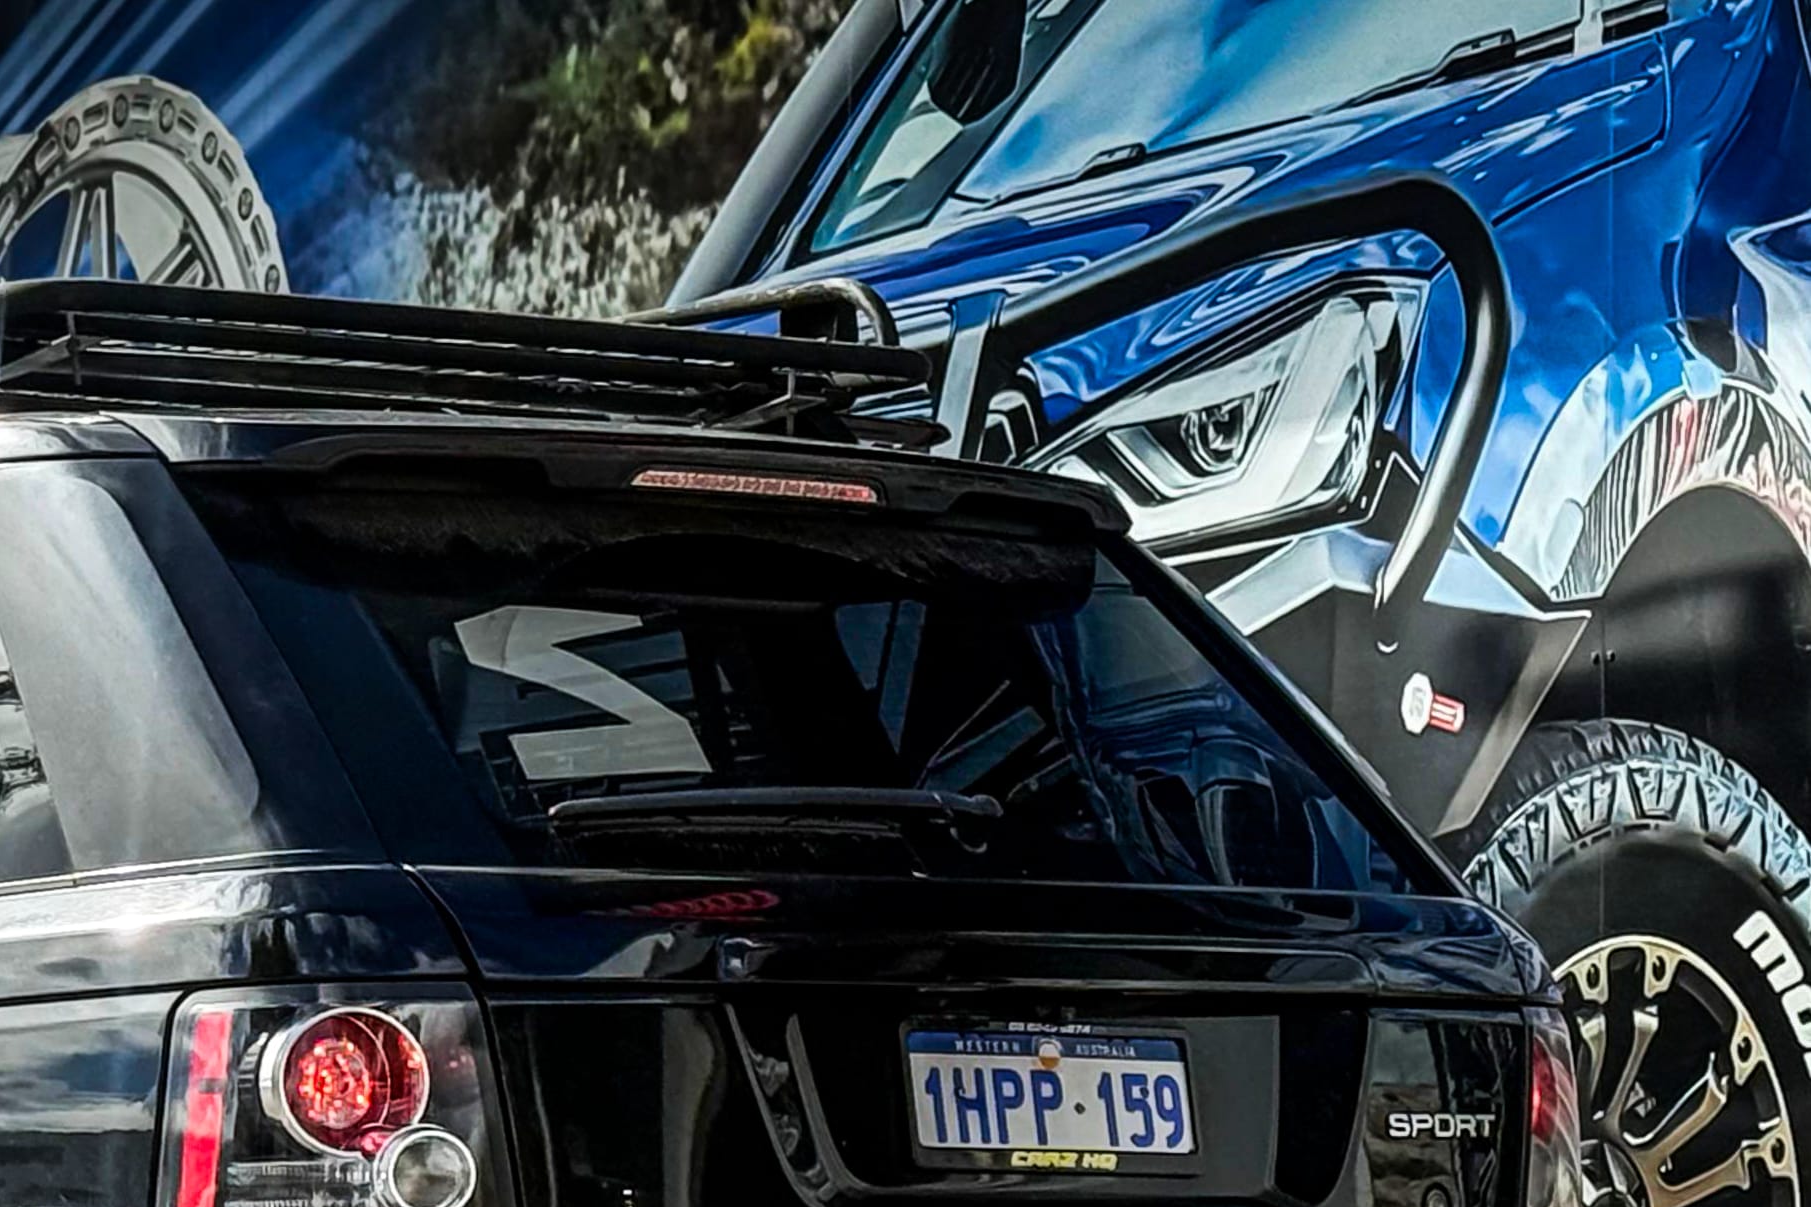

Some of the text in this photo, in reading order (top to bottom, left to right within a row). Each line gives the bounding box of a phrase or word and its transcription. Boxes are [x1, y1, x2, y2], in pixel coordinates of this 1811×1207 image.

[954, 1039, 1137, 1057] WESTERN AUSTRALIA
[1388, 1113, 1495, 1138] SPORT
